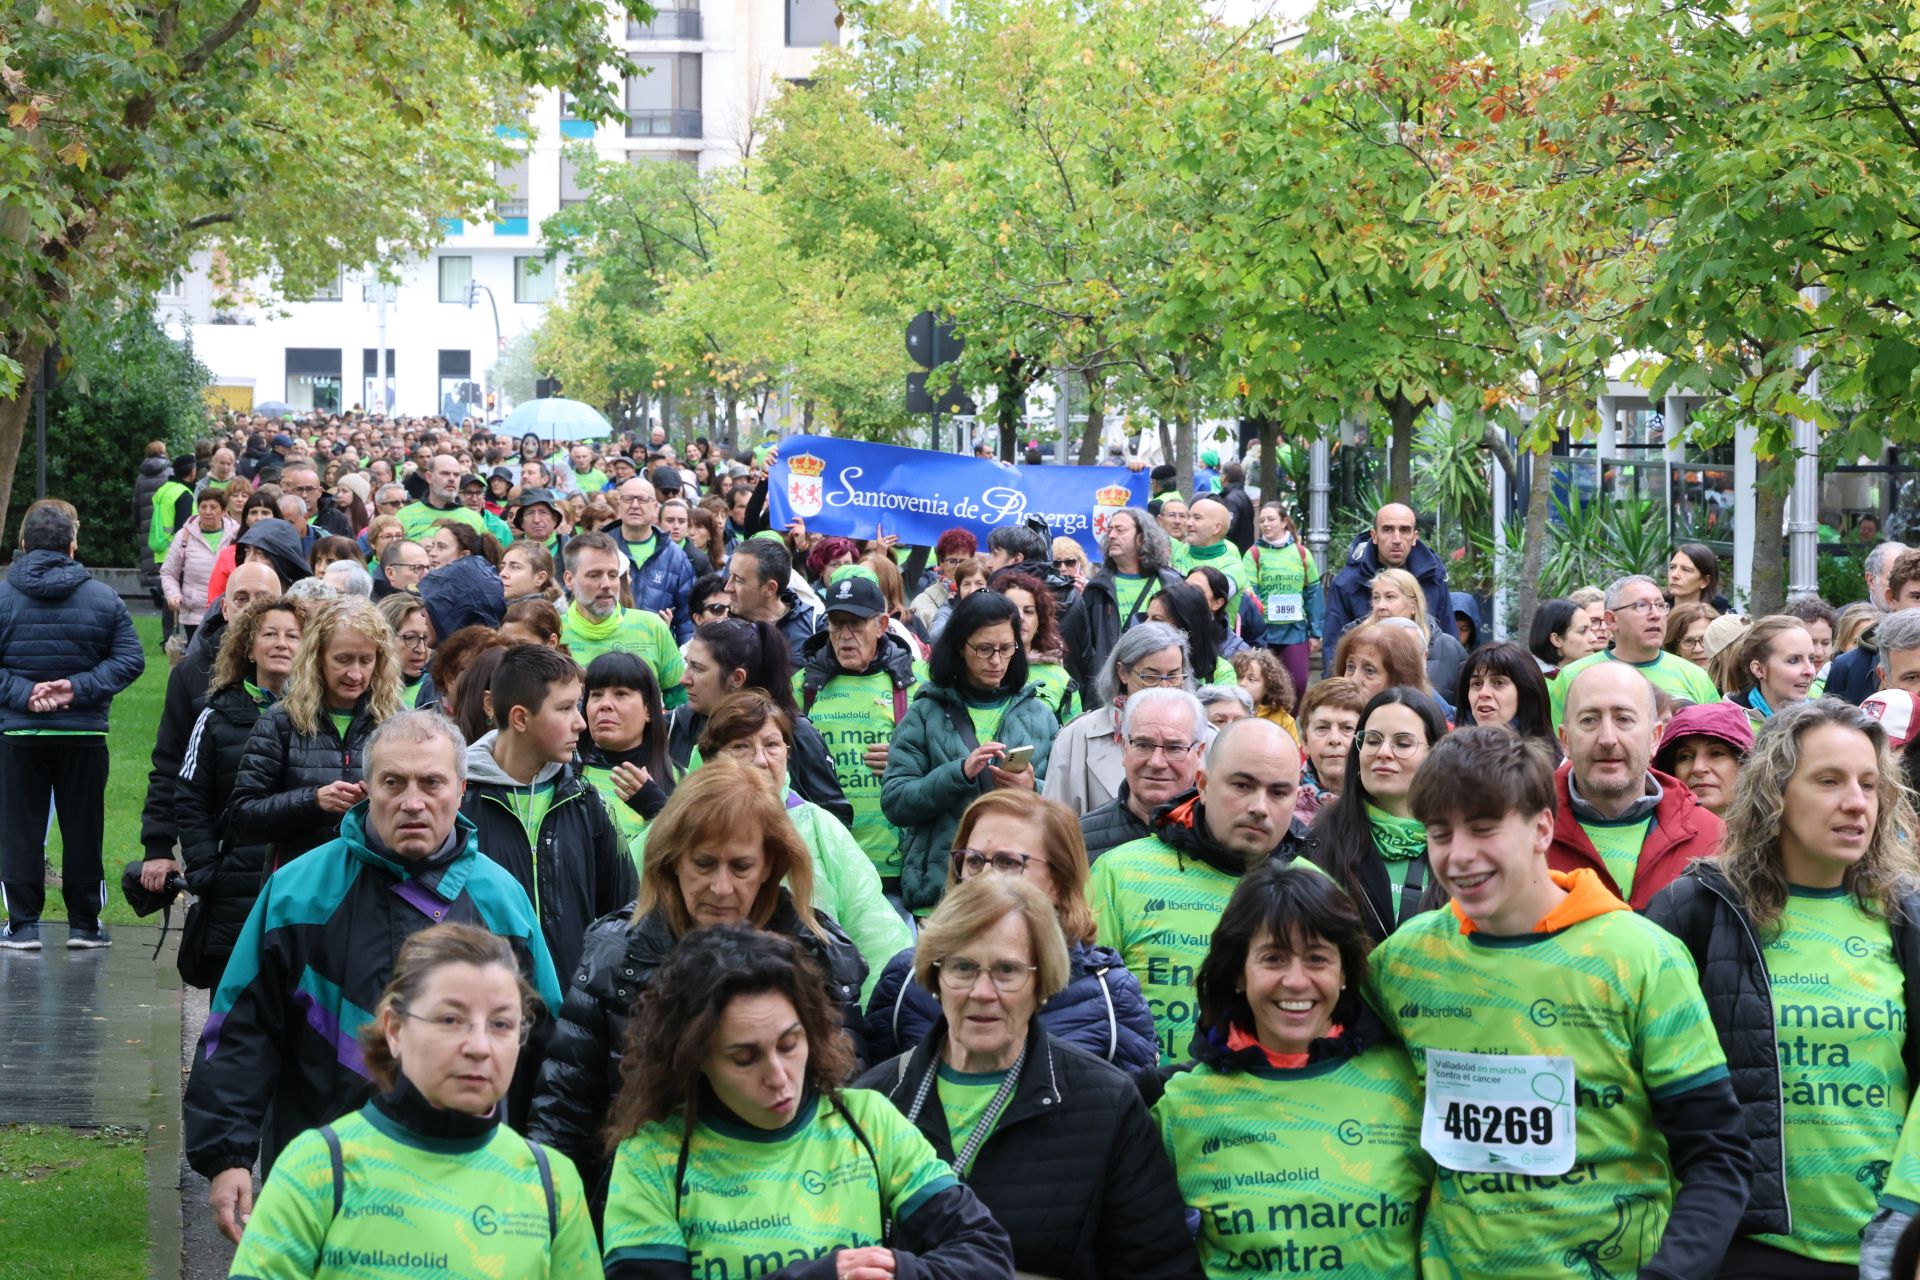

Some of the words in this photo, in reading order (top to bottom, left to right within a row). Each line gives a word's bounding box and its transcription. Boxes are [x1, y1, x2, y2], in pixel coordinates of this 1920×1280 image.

[826, 467, 949, 518] Santovenia
[953, 495, 979, 519] de
[981, 486, 1088, 535] Piserga
[1275, 605, 1295, 614] 3890
[821, 730, 834, 744] n
[1168, 900, 1223, 912] Iberdrola
[1151, 933, 1175, 945] XIII
[1148, 957, 1193, 987] En
[1421, 1003, 1472, 1018] Iberdrola
[1435, 1060, 1476, 1072] Valladolid
[1477, 1065, 1488, 1073] en
[1489, 1065, 1526, 1075] marcha
[1436, 1070, 1461, 1080] contra
[1462, 1071, 1471, 1081] el
[1444, 1101, 1553, 1146] 46269
[1222, 1130, 1277, 1149] Iberdrola
[1234, 1167, 1320, 1188] Valladolid
[707, 1213, 792, 1235] Valladolid
[1211, 1202, 1255, 1236] En
[1268, 1193, 1413, 1231] marcha
[349, 1250, 448, 1269] Valladolid
[1226, 1239, 1344, 1273] contra
